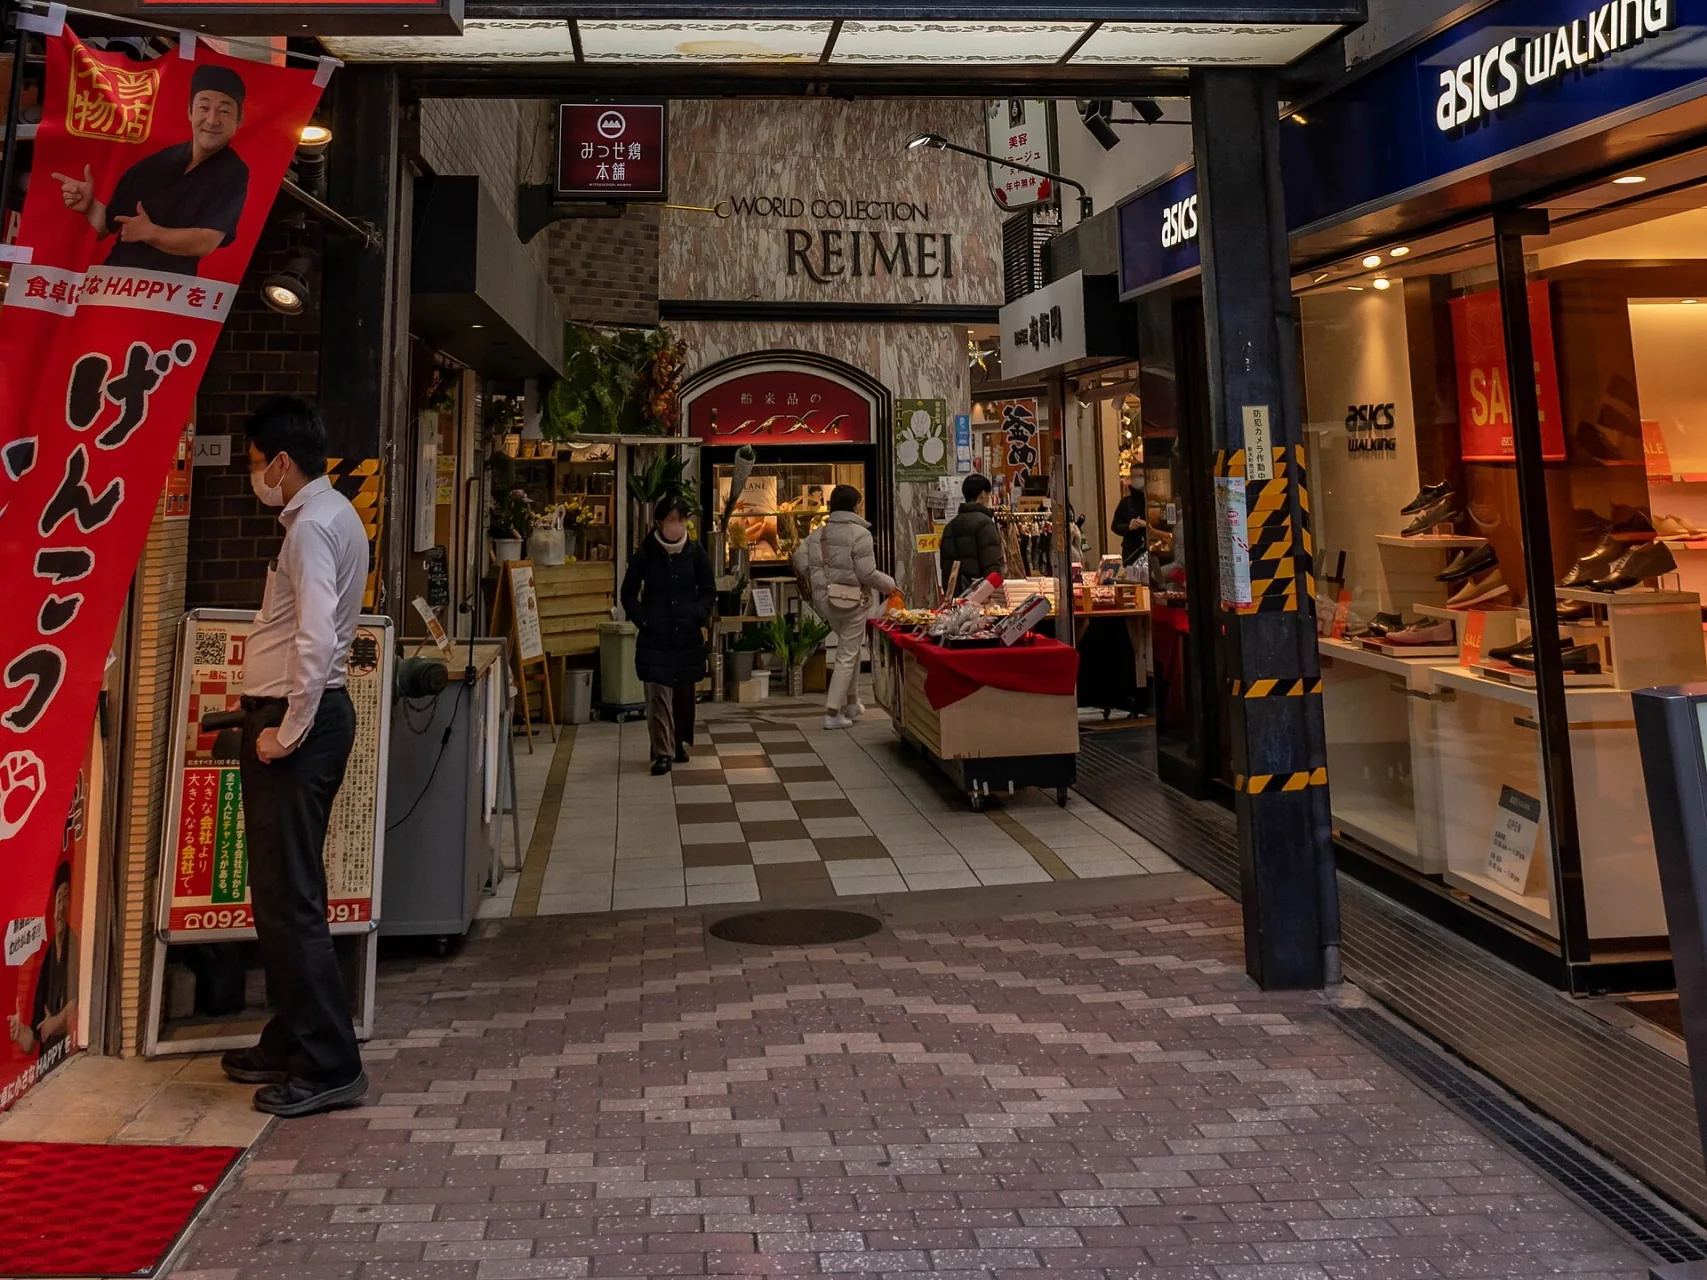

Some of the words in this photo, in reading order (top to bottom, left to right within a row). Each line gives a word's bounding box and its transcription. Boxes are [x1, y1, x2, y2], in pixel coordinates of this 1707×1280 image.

[581, 142, 641, 160] みつせ鶏
[1009, 133, 1028, 149] 美容
[596, 162, 626, 180] 本舗
[1006, 176, 1037, 192] 年中無休
[731, 195, 804, 219] WORLD
[811, 198, 929, 222] COLLECTION
[786, 229, 954, 284] REIMEI
[103, 276, 183, 302] HAPPY
[741, 392, 822, 406] 舶来品の
[194, 443, 221, 457] 入口
[1253, 409, 1266, 479] 防犯カメラ作動中
[2, 339, 196, 734] げんこつ
[1464, 633, 1481, 648] SALE
[180, 773, 201, 896] 大きくなる会社で。
[198, 773, 216, 873] 大きな会社より
[218, 772, 236, 894] 全ての人にチャンスがある。
[36, 1039, 64, 1078] HAPPY
